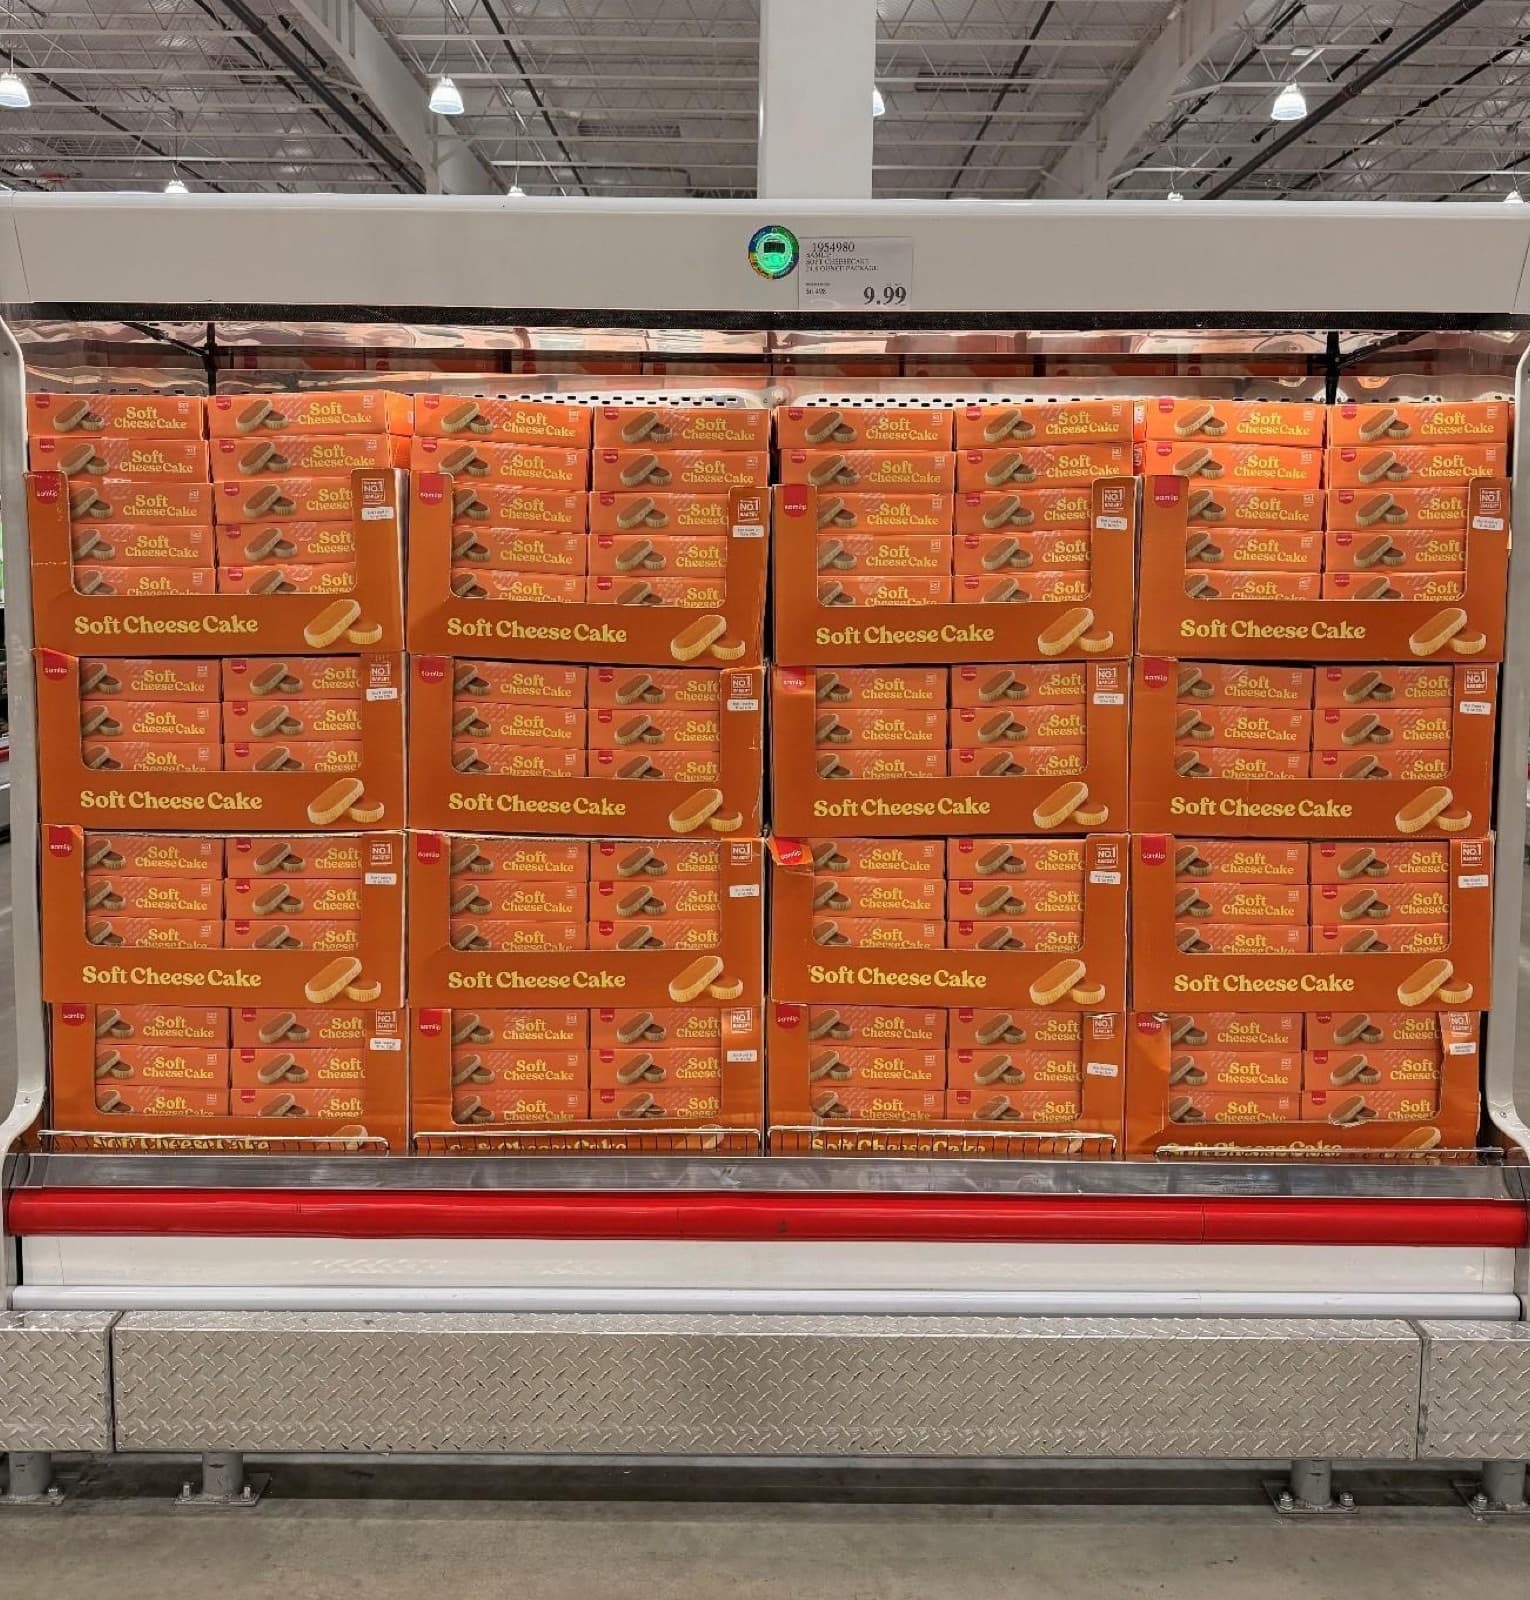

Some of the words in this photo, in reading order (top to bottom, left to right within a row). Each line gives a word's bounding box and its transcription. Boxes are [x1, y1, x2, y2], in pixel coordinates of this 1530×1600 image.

[812, 241, 855, 252] 1954980
[863, 286, 907, 305] 9.99
[127, 407, 157, 419] Soft
[516, 412, 547, 425] Soft
[1059, 413, 1090, 425] Soft
[1249, 412, 1281, 425] Soft
[1434, 413, 1466, 425] Soft
[879, 418, 911, 431] Soft
[313, 445, 346, 458] Soft
[694, 461, 726, 474] Soft
[1433, 456, 1464, 468] Soft
[136, 495, 168, 507] Soft
[75, 617, 121, 634] Soft
[123, 615, 201, 633] Cheese
[203, 615, 258, 632] Cake
[448, 618, 492, 637] Soft
[494, 620, 572, 641] Cheese
[574, 624, 627, 643] Cake
[1180, 619, 1228, 638] Soft
[1231, 620, 1309, 638] Cheese
[1312, 621, 1365, 639] Cake
[816, 627, 861, 644] Soft
[864, 626, 940, 644] Cheese
[941, 625, 994, 642] Cake
[145, 712, 176, 725] Soft
[513, 715, 544, 728] Soft
[1237, 717, 1269, 730] Soft
[874, 719, 905, 732] Soft
[80, 790, 125, 809] Soft
[129, 792, 204, 810] Cheese
[208, 792, 262, 810] Cake
[448, 793, 494, 811] Soft
[497, 795, 572, 814] Cheese
[573, 798, 626, 816] Cake
[1170, 796, 1217, 815] Soft
[1219, 798, 1295, 817] Cheese
[1298, 799, 1352, 817] Cake
[813, 799, 858, 817] Soft
[861, 798, 937, 816] Cheese
[938, 797, 990, 815] Cake
[148, 888, 179, 900] Soft
[514, 891, 545, 903] Soft
[872, 888, 903, 900] Soft
[1235, 894, 1267, 907] Soft
[82, 966, 129, 984] Soft
[131, 968, 205, 985] Cheese
[208, 969, 262, 987] Cake
[448, 971, 494, 989] Soft
[496, 972, 571, 989] Cheese
[573, 971, 626, 988] Cake
[810, 966, 854, 984] Soft
[858, 968, 932, 986] Cheese
[934, 970, 987, 988] Cake
[1174, 975, 1221, 992] Soft
[1223, 975, 1299, 992] Cheese
[1301, 974, 1354, 992] Cake
[155, 1057, 186, 1069] Soft
[516, 1059, 548, 1072] Soft
[874, 1058, 905, 1070] Soft
[1230, 1063, 1261, 1075] Soft
